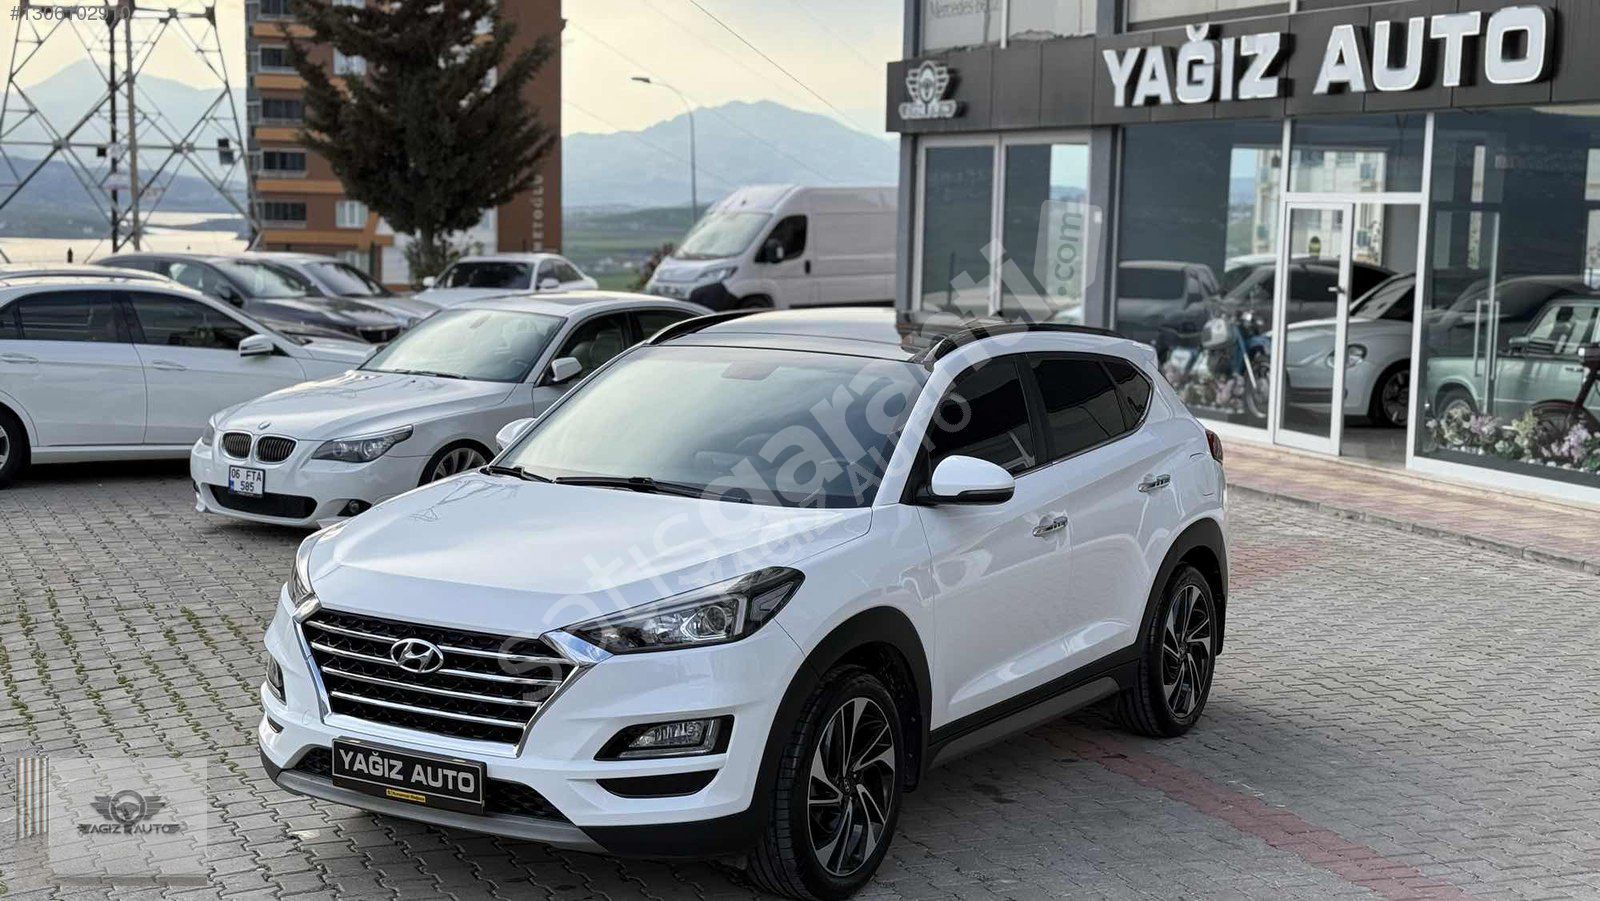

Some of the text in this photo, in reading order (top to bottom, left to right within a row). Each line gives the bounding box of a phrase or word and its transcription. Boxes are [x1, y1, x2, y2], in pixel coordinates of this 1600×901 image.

[1103, 5, 1548, 107] YAĞIZ AUTO
[231, 468, 262, 482] 06 FTA
[339, 749, 475, 793] YAĞIZ AUTO
